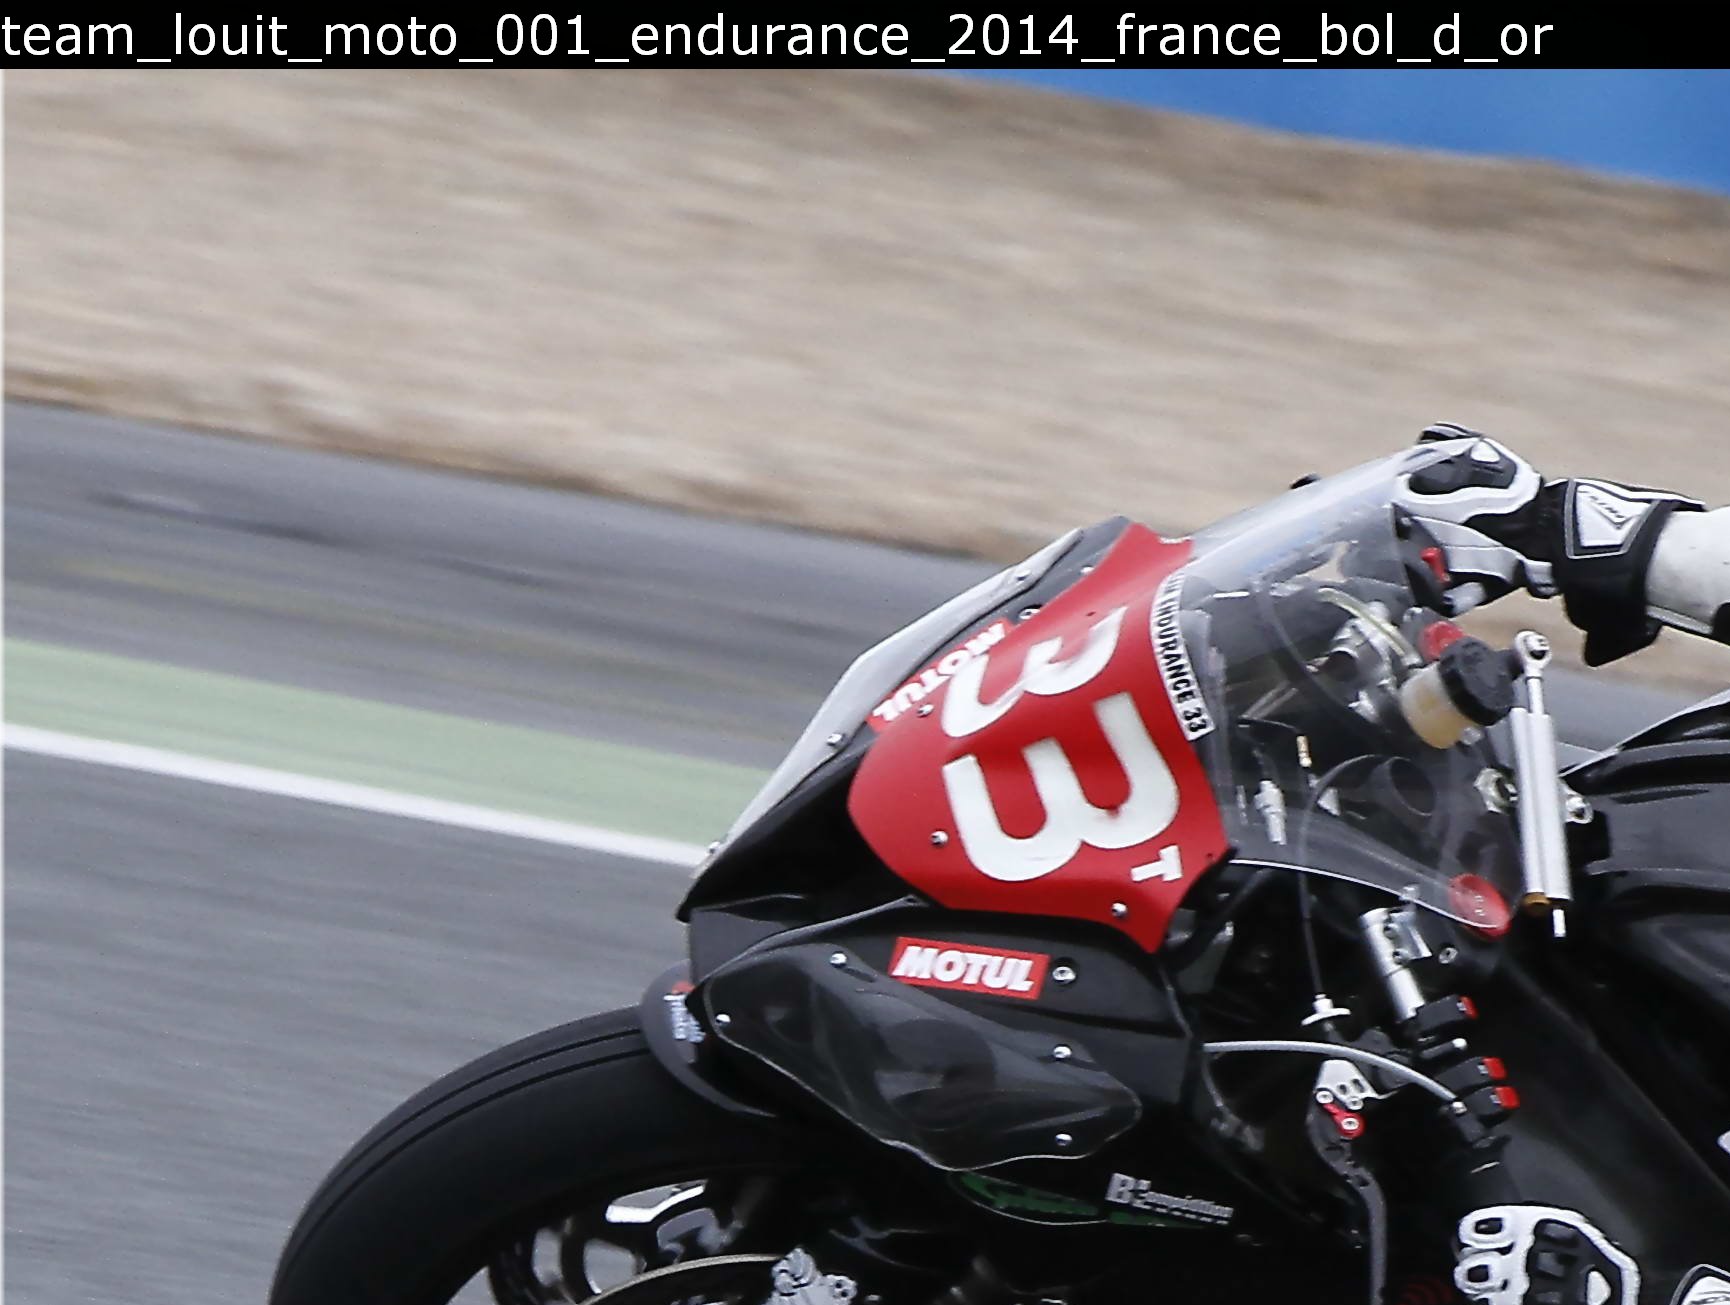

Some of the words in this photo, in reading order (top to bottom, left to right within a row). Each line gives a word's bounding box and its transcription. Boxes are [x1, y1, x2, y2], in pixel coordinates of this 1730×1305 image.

[872, 621, 1007, 722] MOTUL
[941, 606, 1180, 882] 33
[1130, 844, 1183, 882] T
[1183, 706, 1207, 733] 33
[891, 945, 1035, 992] MOTUL
